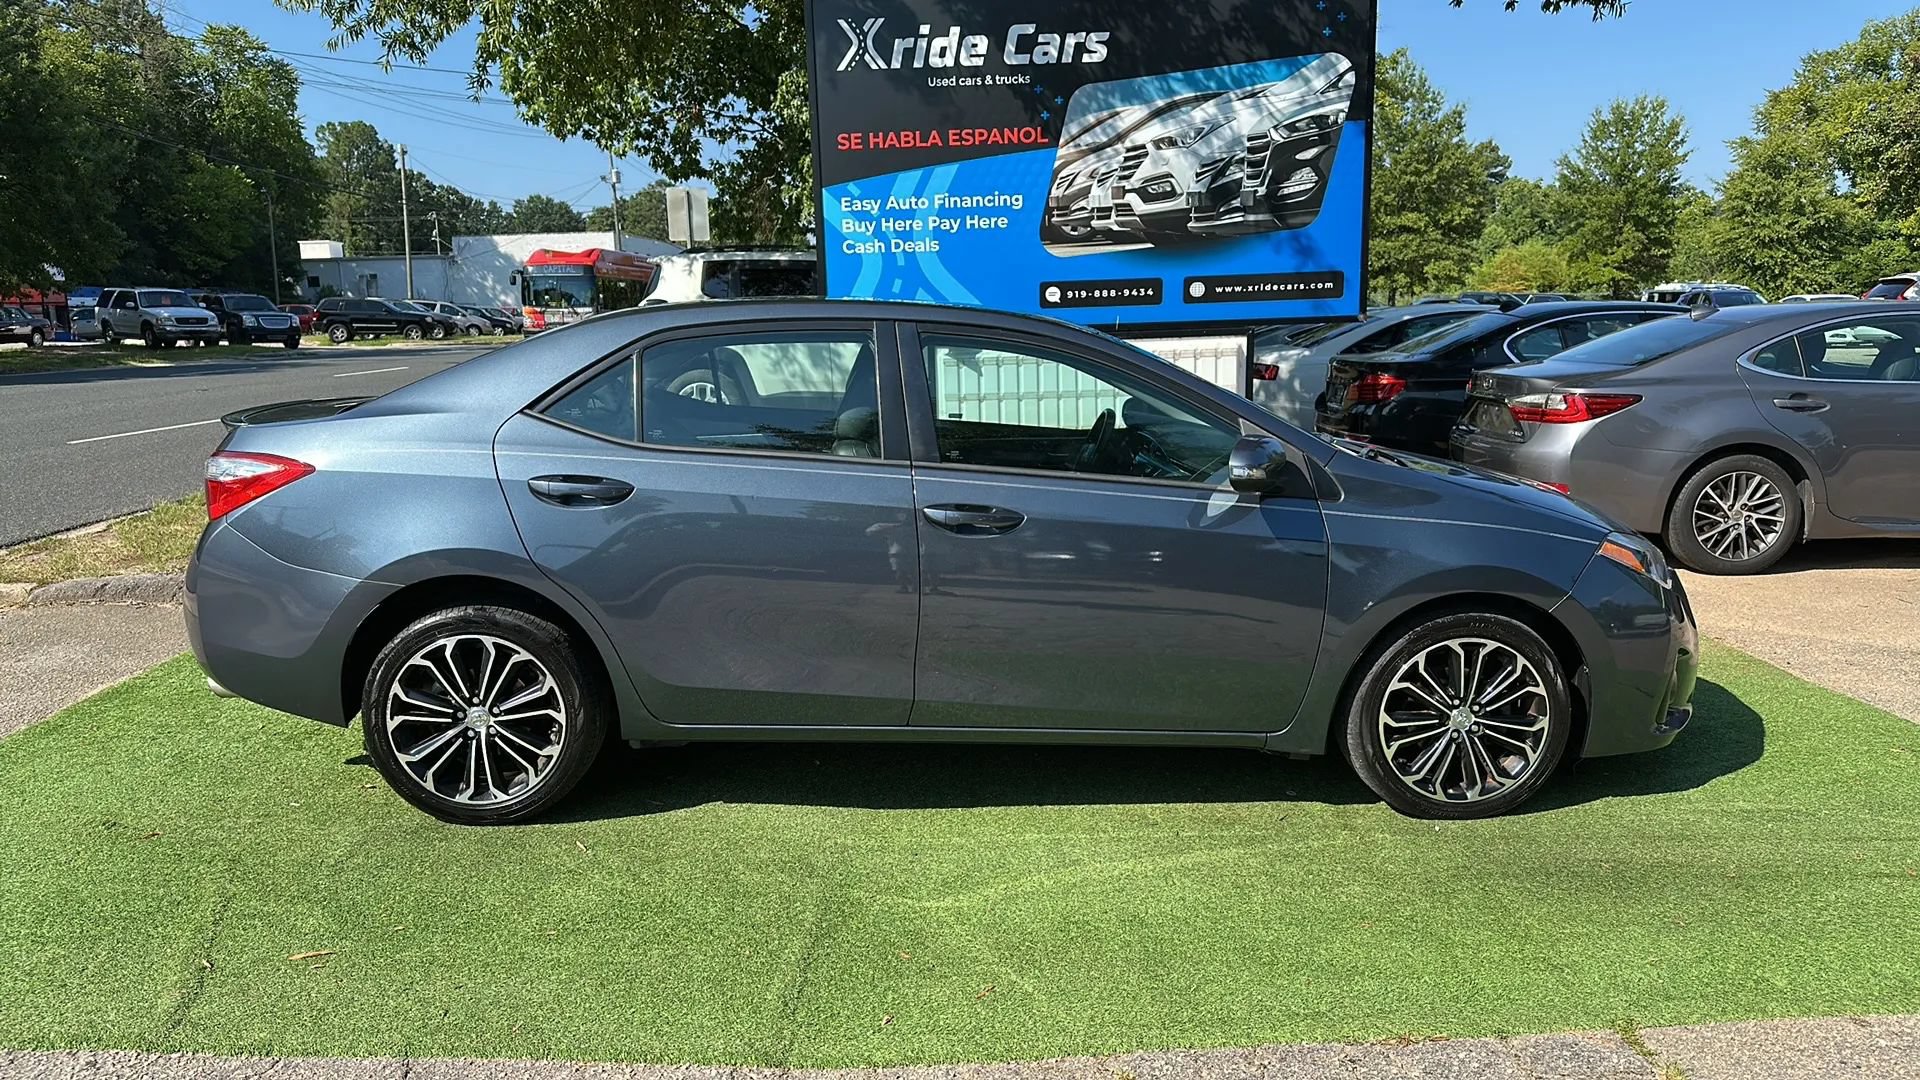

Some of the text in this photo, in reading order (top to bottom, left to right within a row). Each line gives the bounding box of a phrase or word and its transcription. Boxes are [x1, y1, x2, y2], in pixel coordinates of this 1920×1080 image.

[1003, 23, 1110, 66] Cars
[928, 74, 1031, 88] Used cars & trucks
[836, 126, 1049, 151] SE HABLA ESPANOL
[840, 191, 1023, 214] Easy Auto Financing
[841, 214, 1009, 236] Buy Here Pay Here
[842, 237, 940, 255] Cash Deals
[543, 265, 576, 274] CAPITAL
[1066, 287, 1155, 299] 919-888-9434
[1215, 281, 1334, 293] www.xridecars.com
